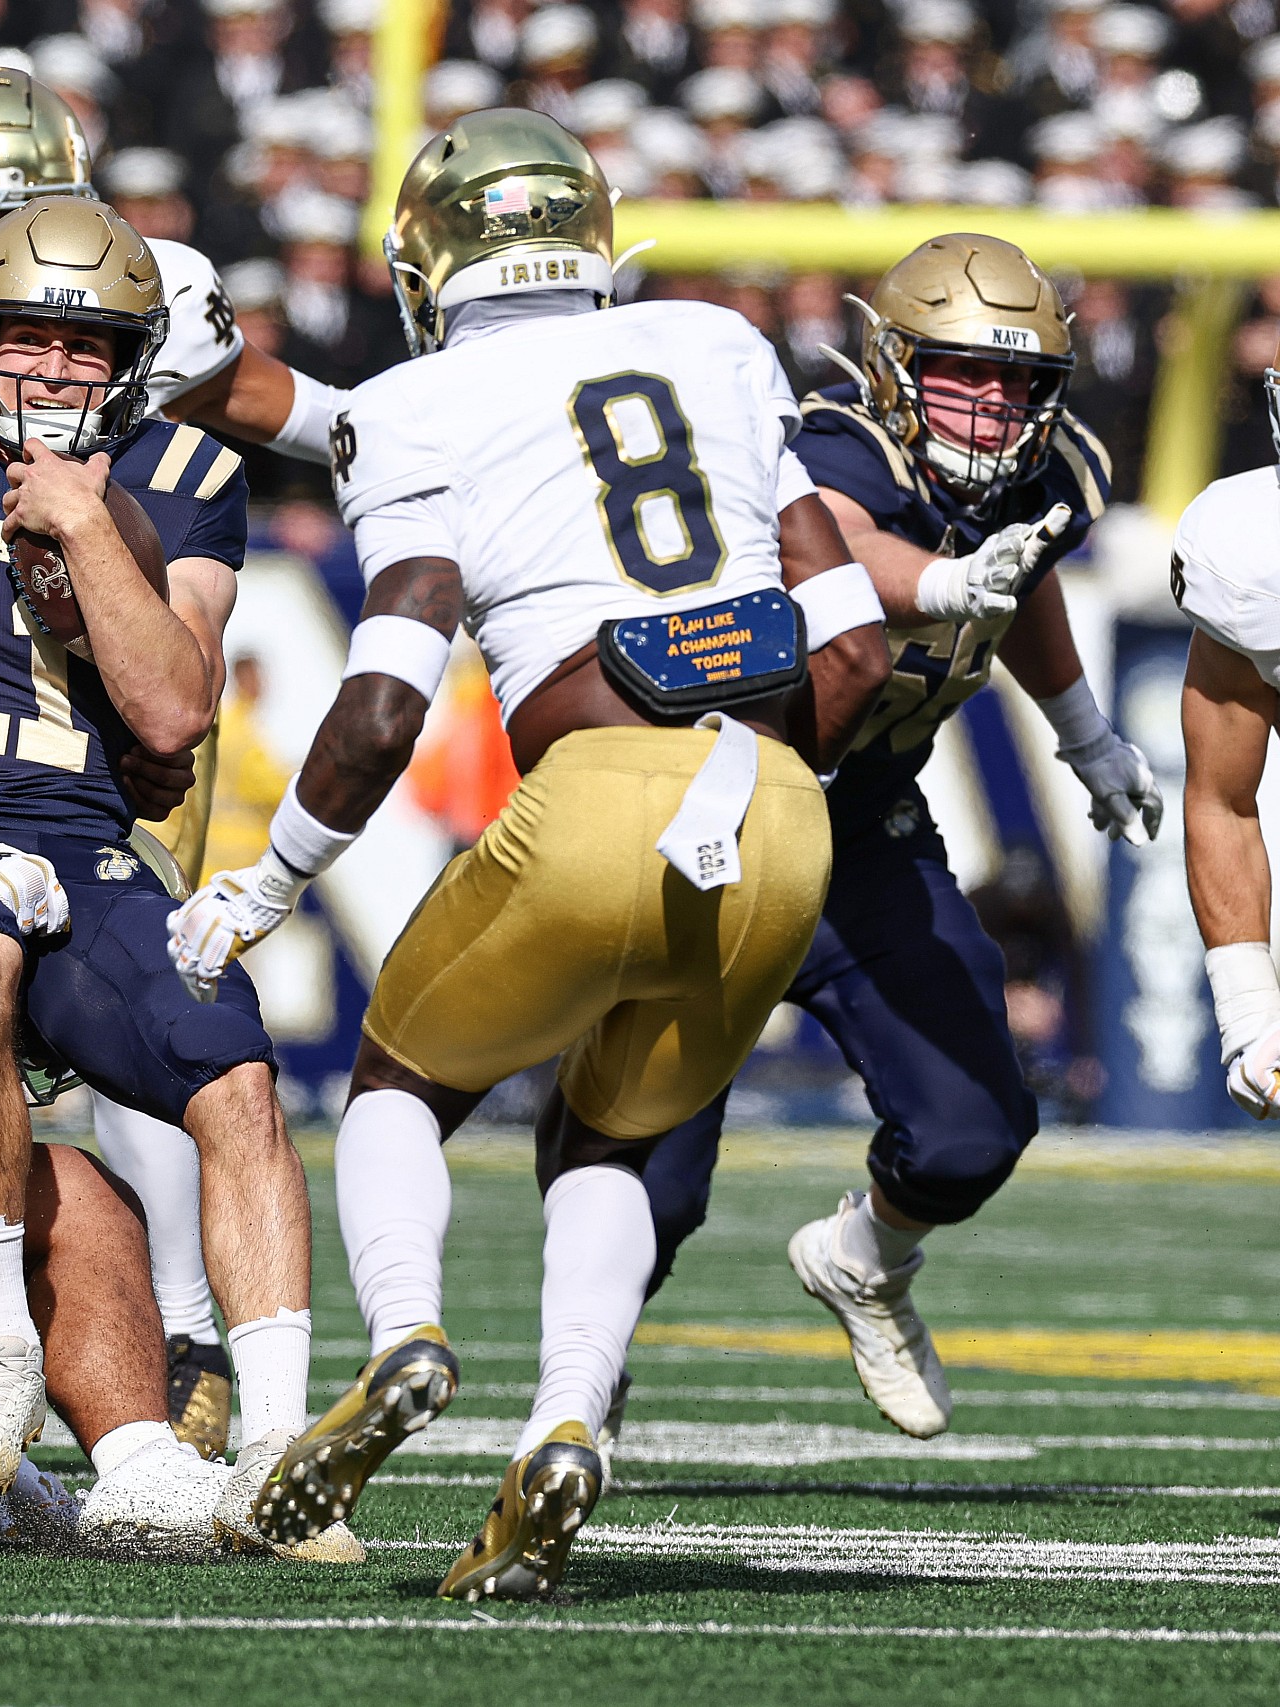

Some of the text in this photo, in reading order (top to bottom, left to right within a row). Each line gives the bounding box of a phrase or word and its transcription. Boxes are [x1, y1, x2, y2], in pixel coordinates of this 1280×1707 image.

[501, 259, 579, 285] IRISH
[43, 286, 87, 307] NAVY
[992, 327, 1029, 348] NAVY
[566, 369, 728, 598] 8
[707, 612, 735, 629] LIKE
[667, 629, 752, 657] A CHAMPION
[692, 651, 741, 670] TODAY
